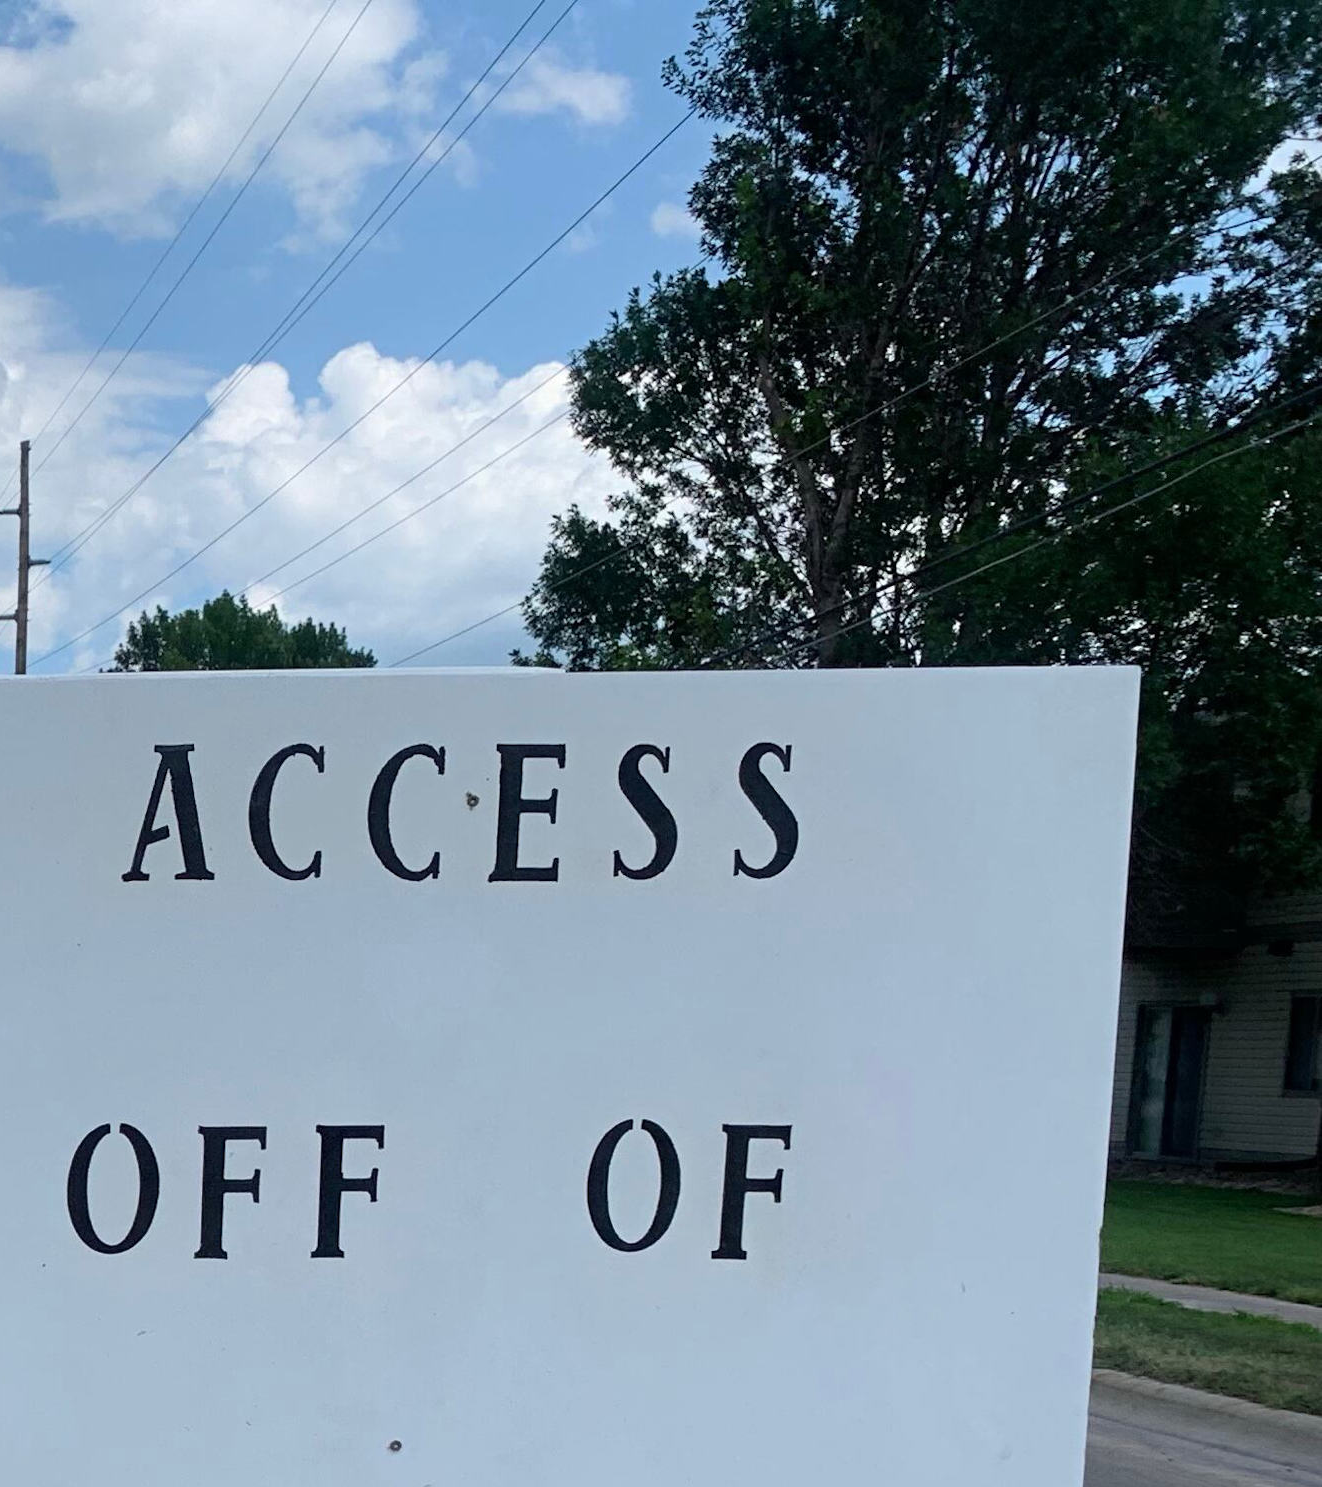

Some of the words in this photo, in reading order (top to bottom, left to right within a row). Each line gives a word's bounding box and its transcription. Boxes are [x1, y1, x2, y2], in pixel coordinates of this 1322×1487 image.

[122, 741, 800, 883] ACCESS
[66, 1122, 387, 1260] OFF
[586, 1118, 793, 1260] OF
